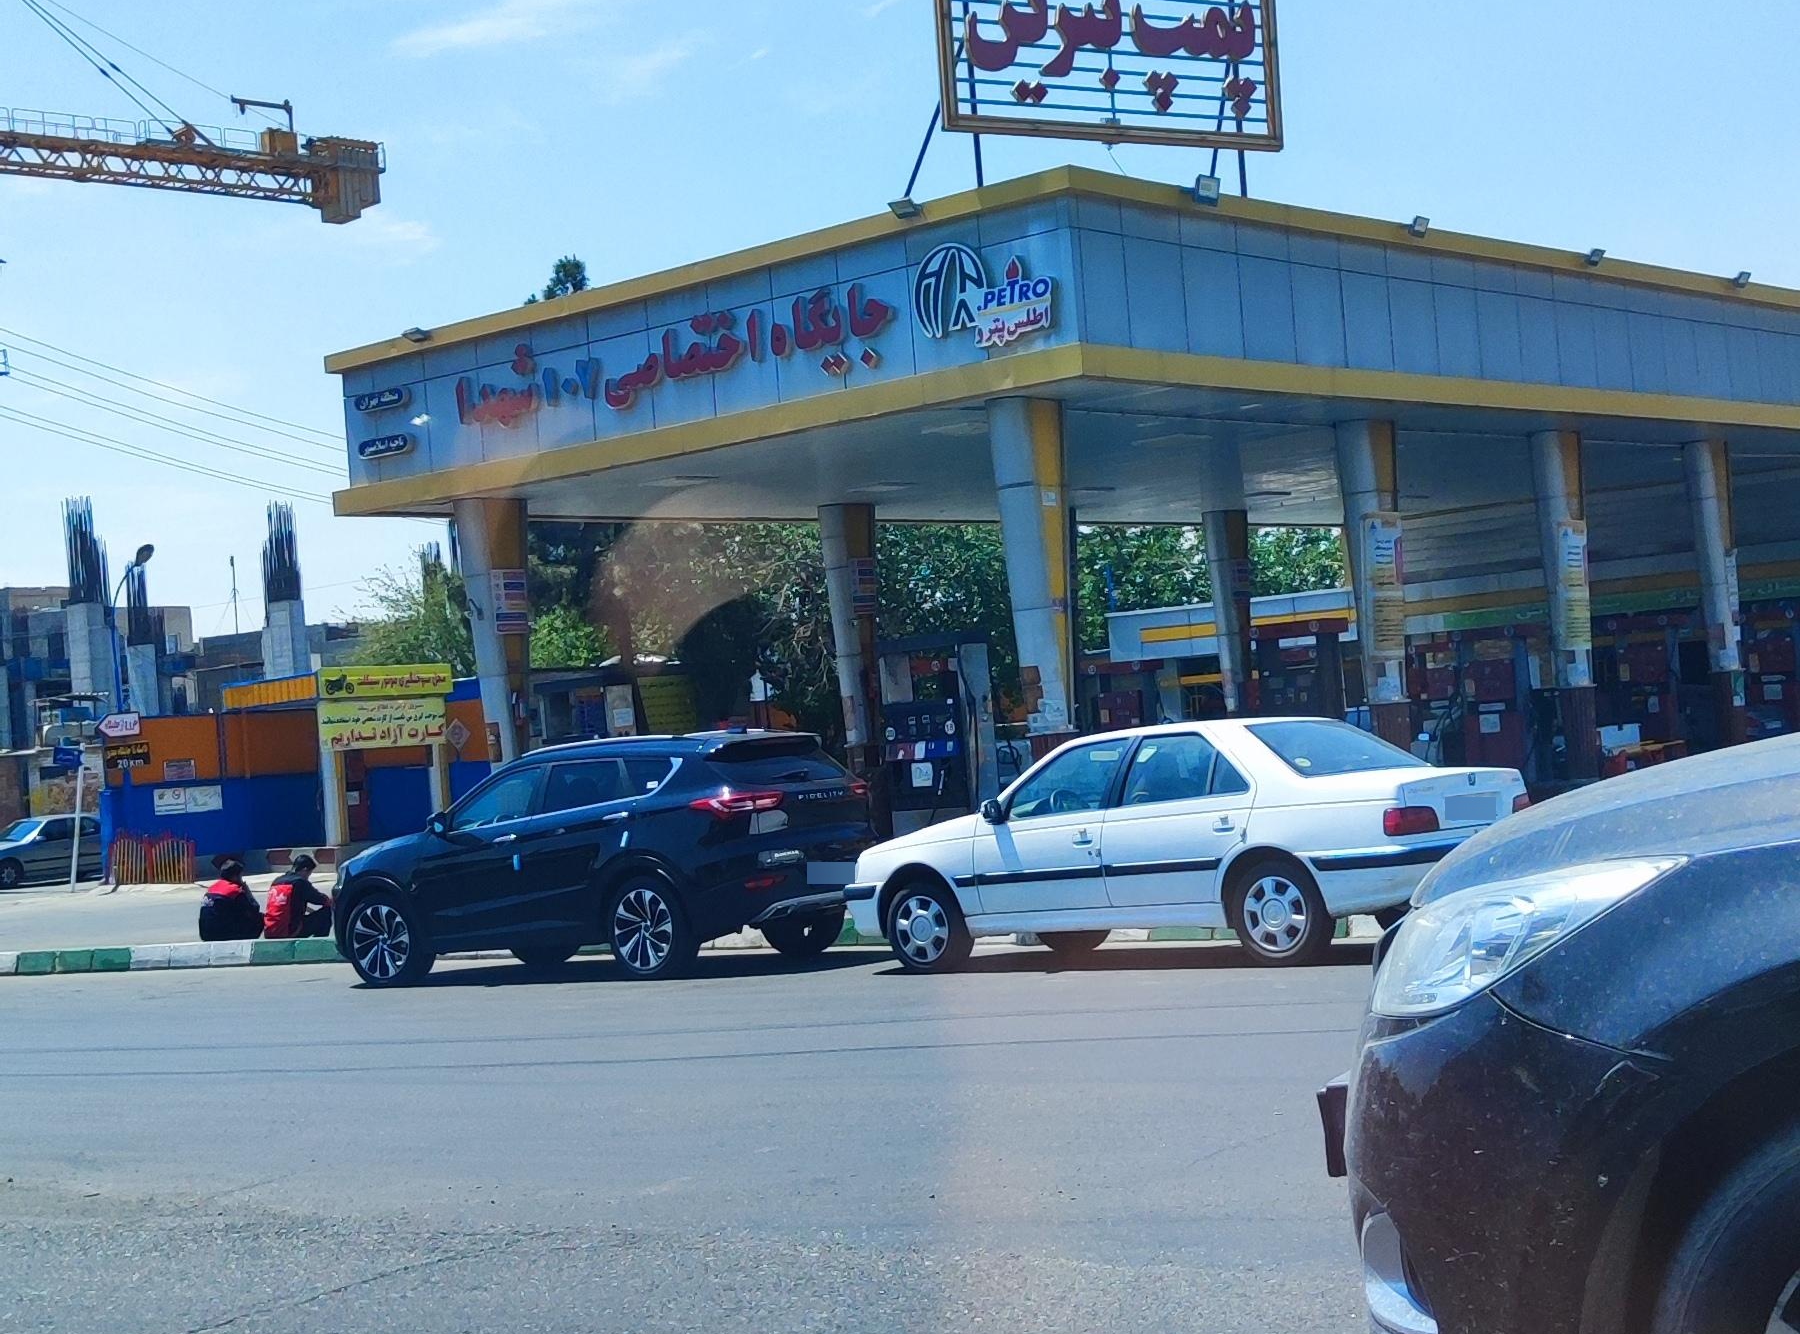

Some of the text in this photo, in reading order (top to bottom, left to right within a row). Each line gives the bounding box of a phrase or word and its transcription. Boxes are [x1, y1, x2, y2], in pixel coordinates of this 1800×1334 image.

[1129, 0, 1256, 118] پمپ
[771, 282, 893, 376] جایگاه
[976, 305, 1049, 344] اطلس پترو
[605, 309, 760, 409] اختصاصی
[455, 343, 540, 427] شهدا
[360, 394, 379, 409] تهران
[331, 726, 377, 748] نداریم
[379, 723, 405, 745] آزاد
[407, 723, 445, 742] کارت
[116, 758, 129, 769] 20
